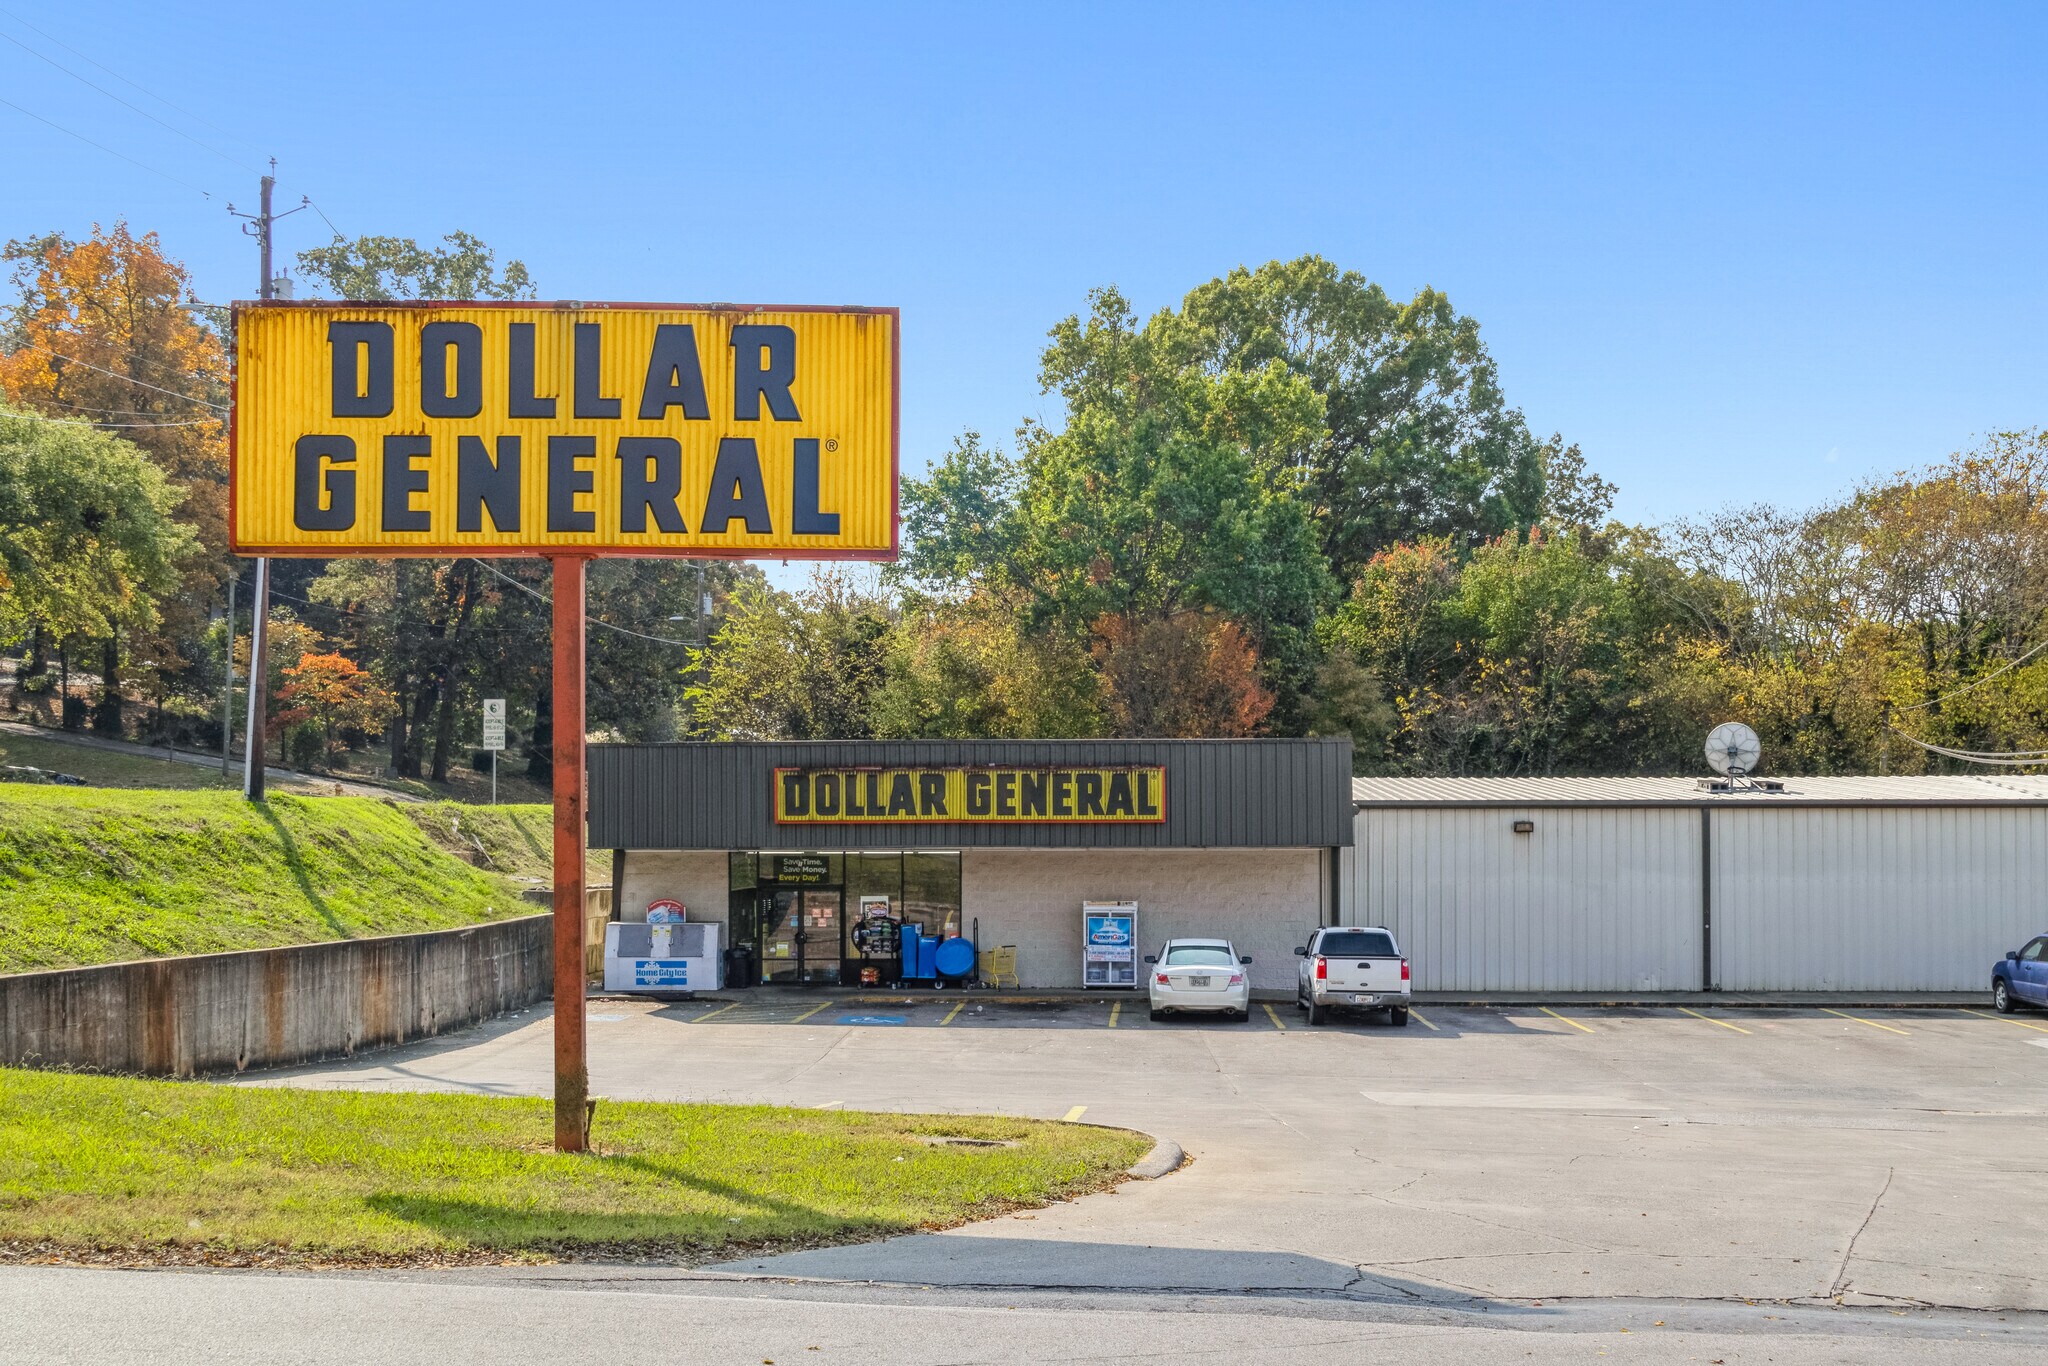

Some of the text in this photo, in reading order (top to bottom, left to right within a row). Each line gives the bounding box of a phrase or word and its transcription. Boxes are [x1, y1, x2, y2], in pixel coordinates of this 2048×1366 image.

[327, 320, 802, 422] DOLLAR
[783, 773, 948, 816] DOLLAR
[659, 969, 674, 978] City
